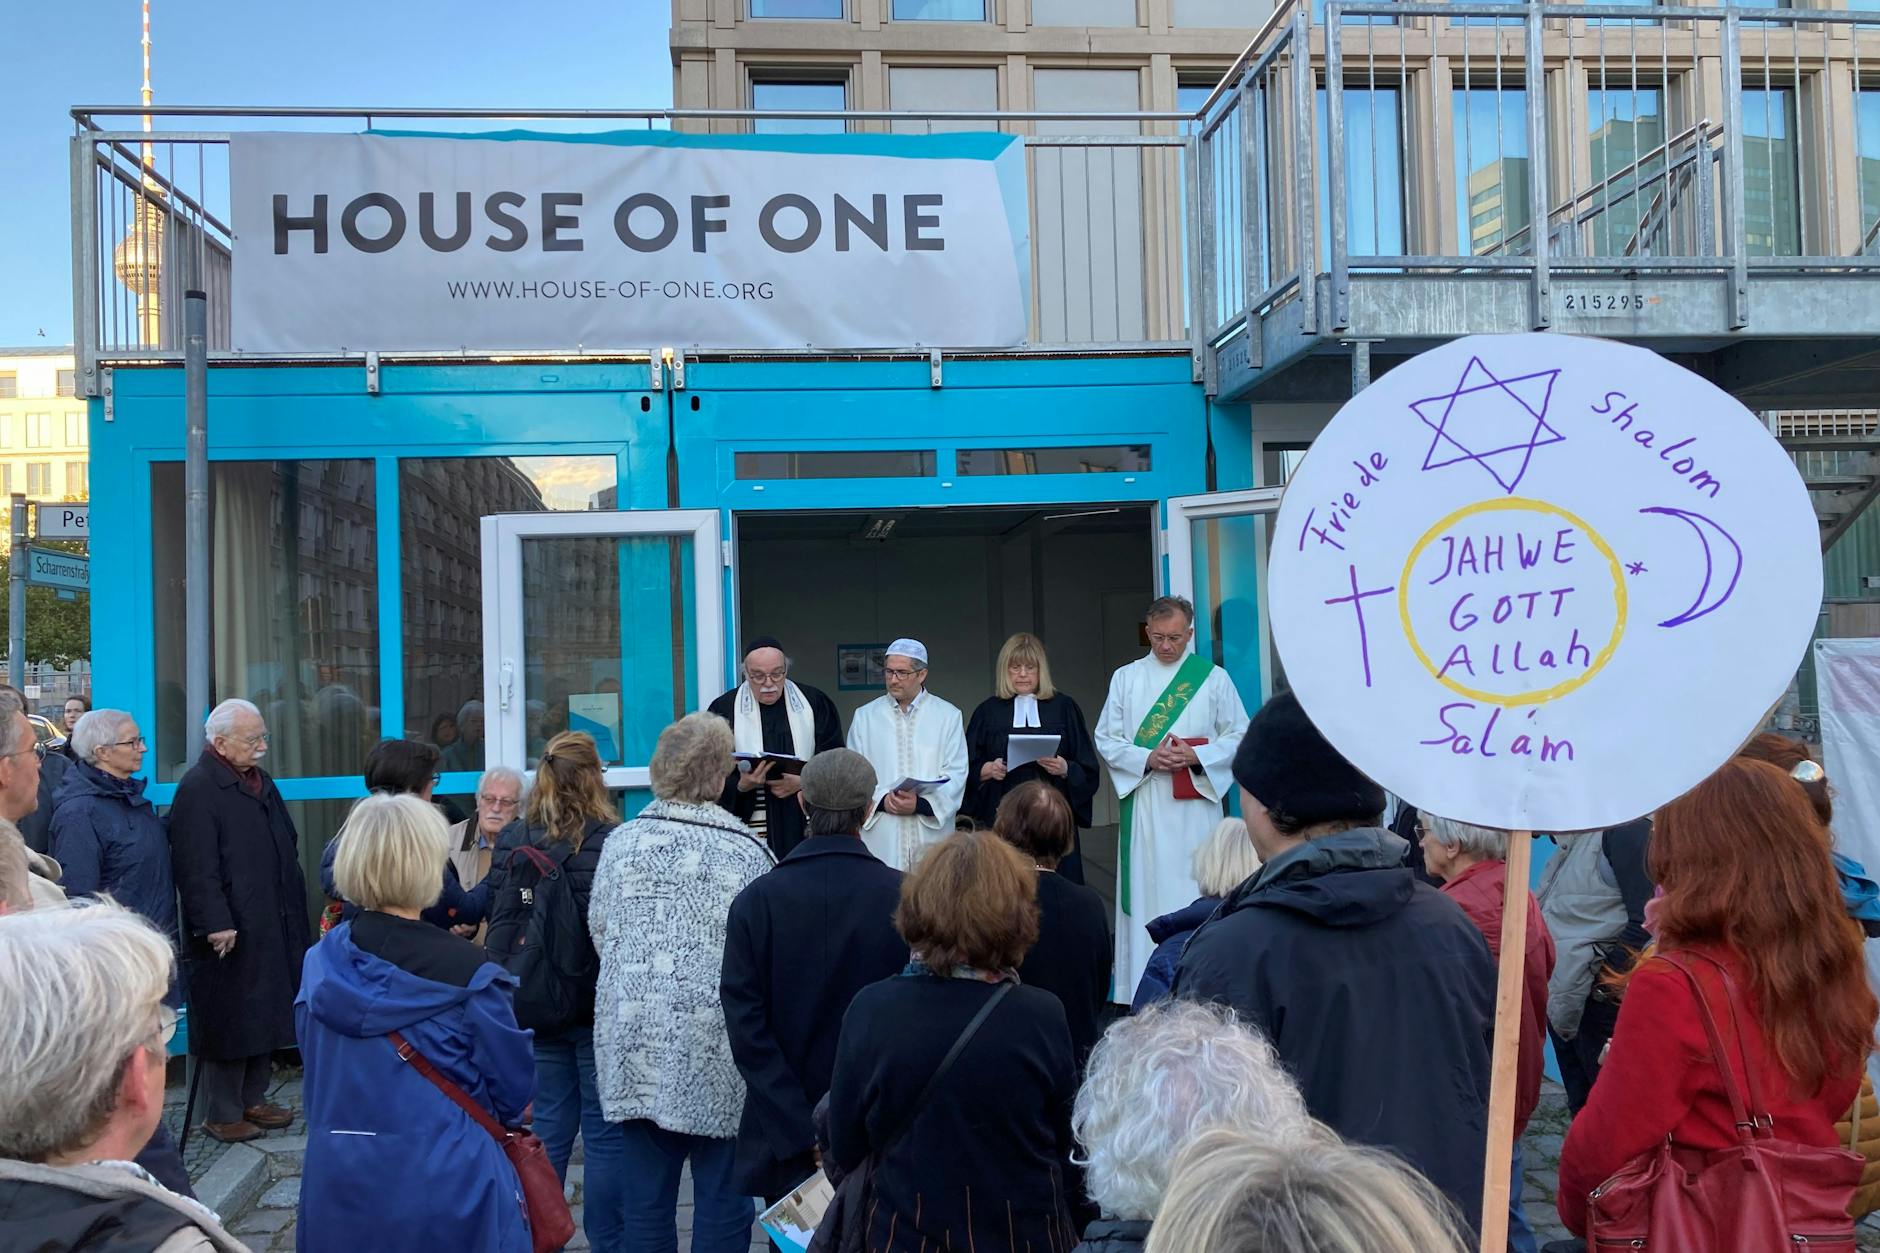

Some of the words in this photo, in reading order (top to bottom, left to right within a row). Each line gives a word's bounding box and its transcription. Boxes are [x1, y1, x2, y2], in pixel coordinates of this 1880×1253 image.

[273, 191, 584, 255] HOUSE
[613, 192, 731, 254] OF
[758, 193, 945, 254] ONE
[447, 280, 774, 300] WWW.HOUSE-OF-ONE.ORG
[1566, 294, 1643, 310] 215295
[1590, 391, 1721, 499] Shalom
[1299, 451, 1389, 552] Friede
[1428, 529, 1576, 585] JAHWE
[1449, 587, 1575, 633] GOTT
